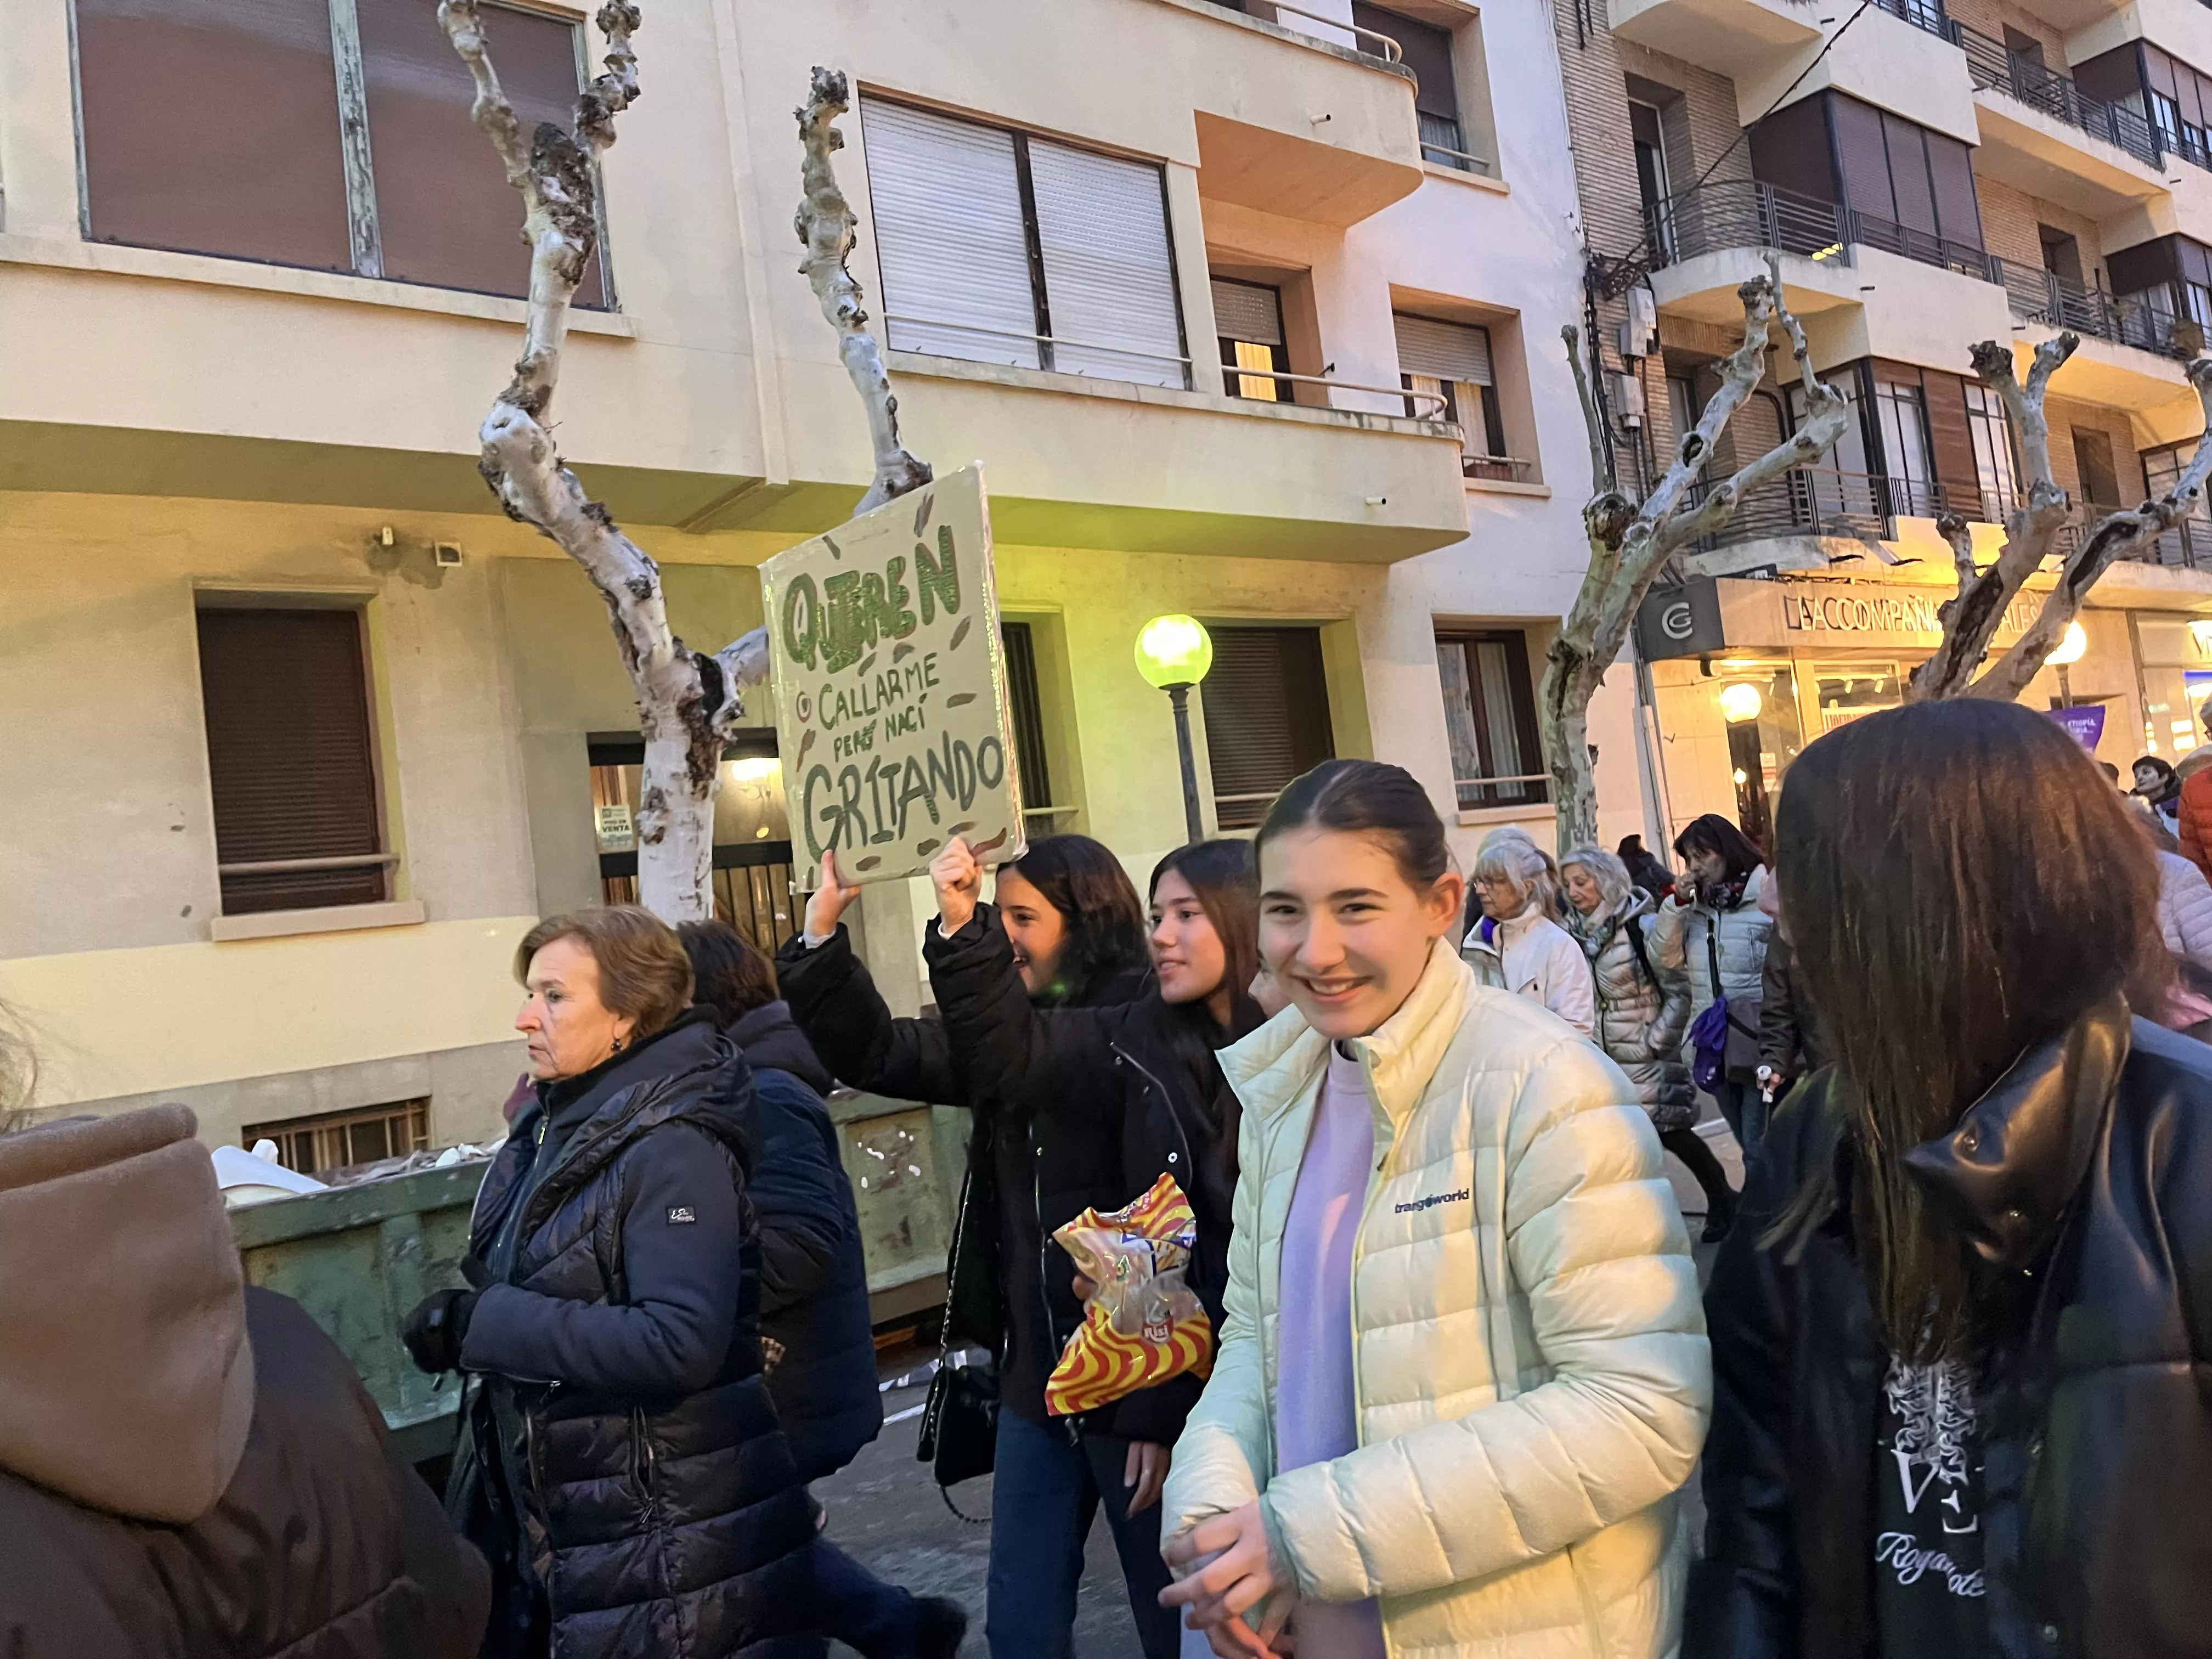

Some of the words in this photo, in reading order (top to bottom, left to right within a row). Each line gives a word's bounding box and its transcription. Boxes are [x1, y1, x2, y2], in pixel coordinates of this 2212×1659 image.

[2000, 603, 2039, 633] ALES
[819, 652, 940, 730] CALLARME
[804, 730, 1004, 865] GRITANDO
